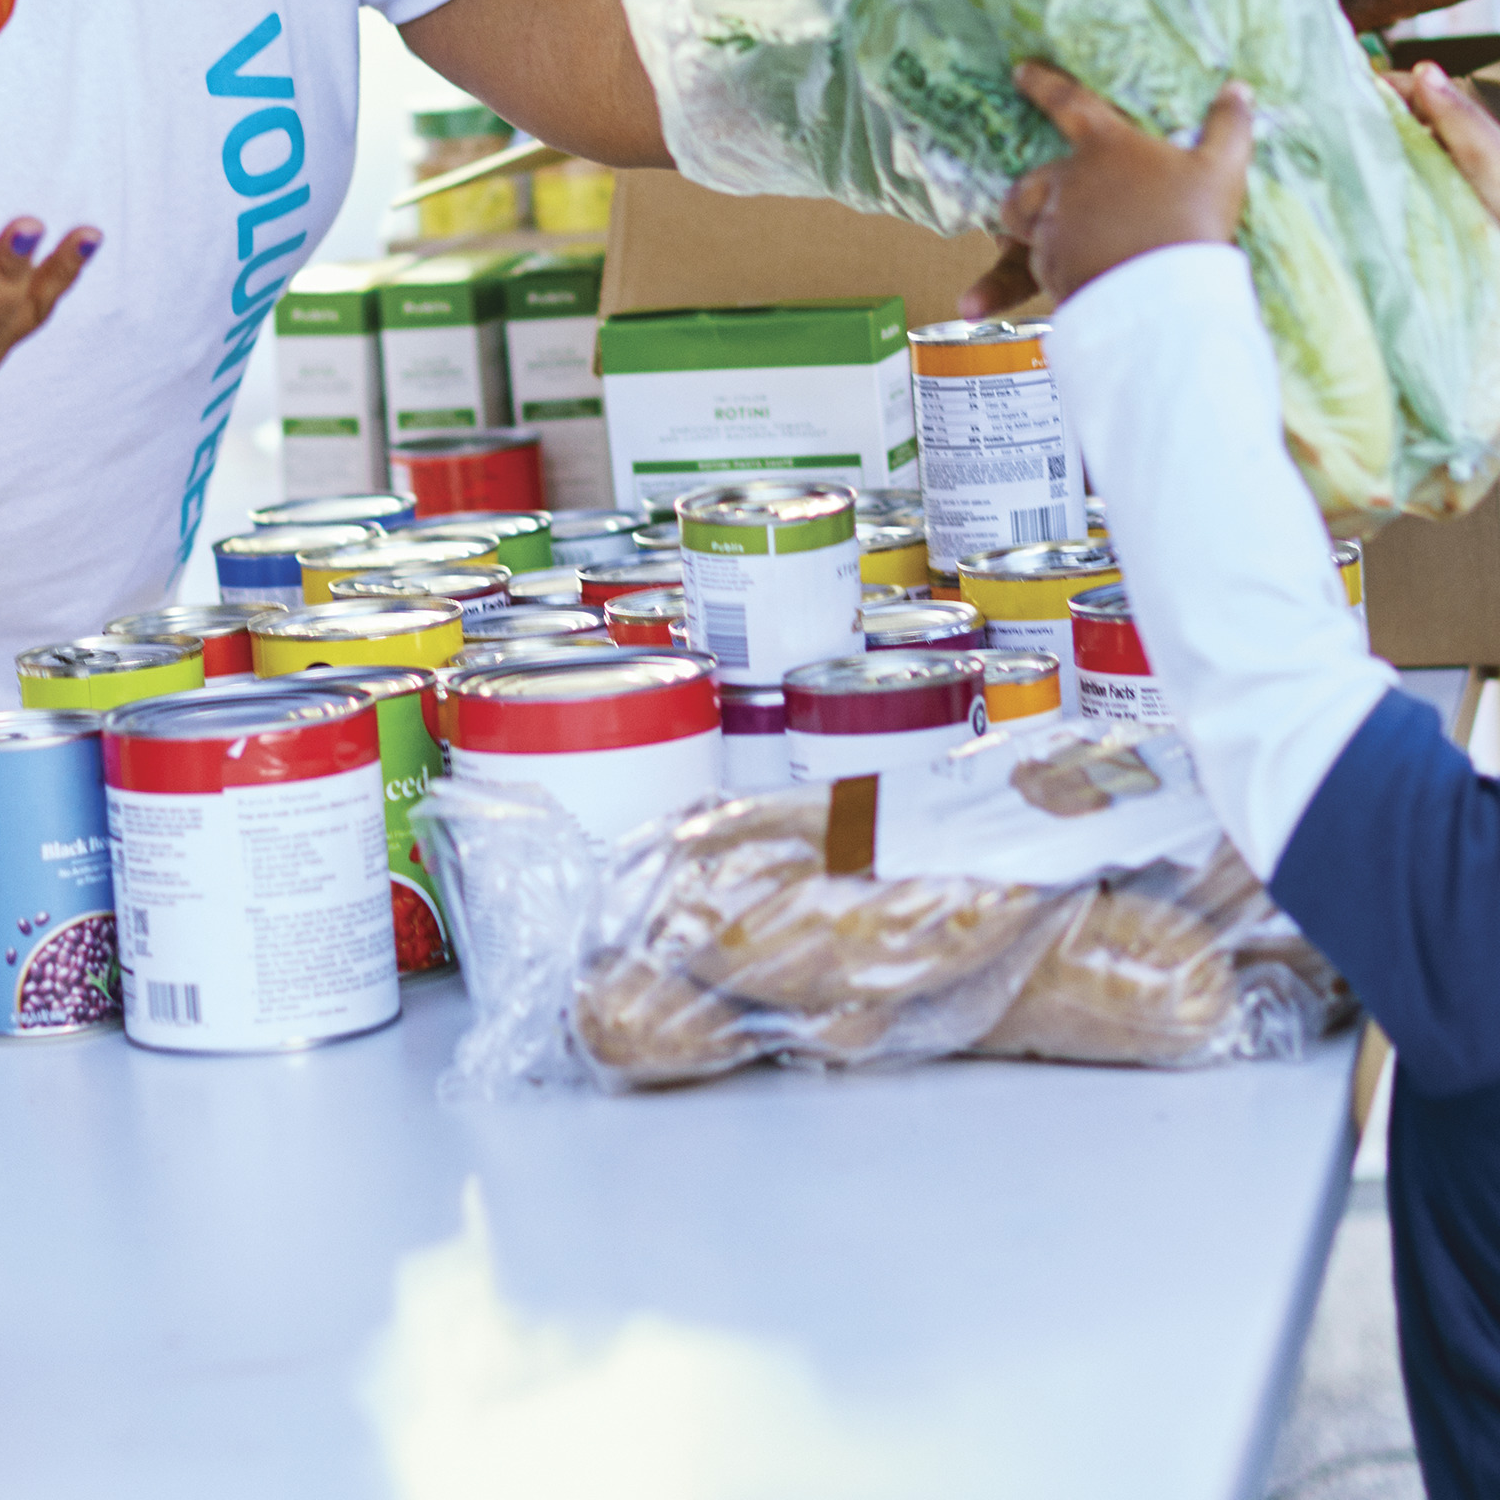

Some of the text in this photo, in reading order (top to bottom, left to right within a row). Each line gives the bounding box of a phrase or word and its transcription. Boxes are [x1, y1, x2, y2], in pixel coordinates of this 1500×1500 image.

[714, 407, 770, 420] ROTINI
[386, 764, 430, 801] ced
[41, 838, 88, 861] Black
